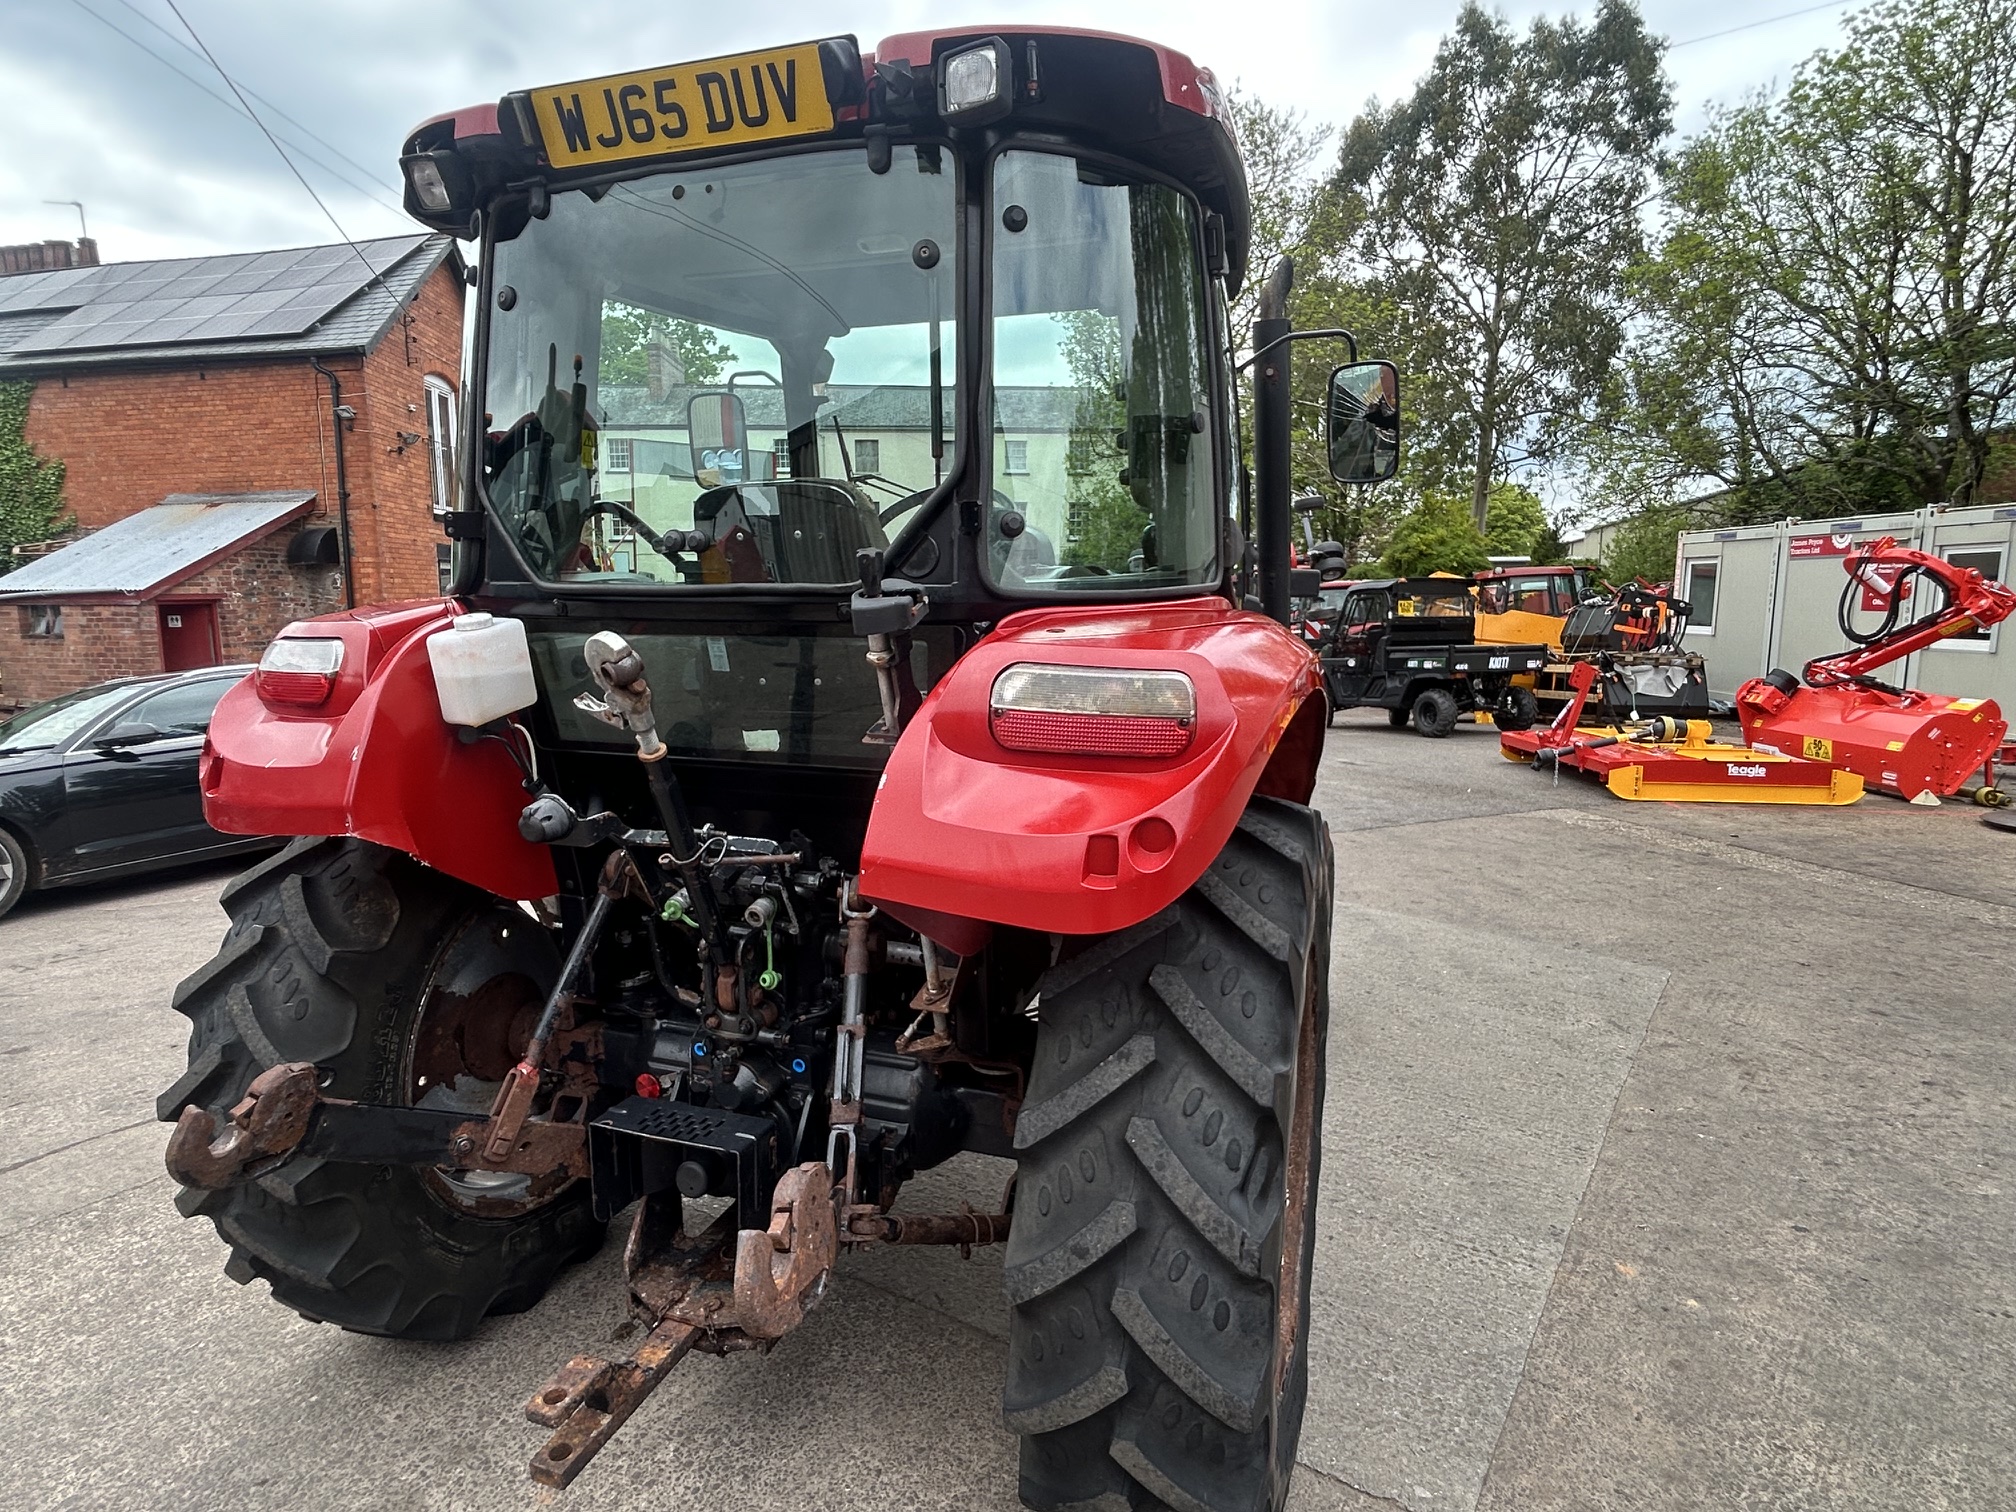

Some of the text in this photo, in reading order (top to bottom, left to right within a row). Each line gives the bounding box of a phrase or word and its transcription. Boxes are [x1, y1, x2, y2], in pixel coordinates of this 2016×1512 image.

[553, 59, 796, 153] WJ65 DUV
[1813, 738, 1823, 751] 50
[1726, 763, 1767, 778] Teagle
